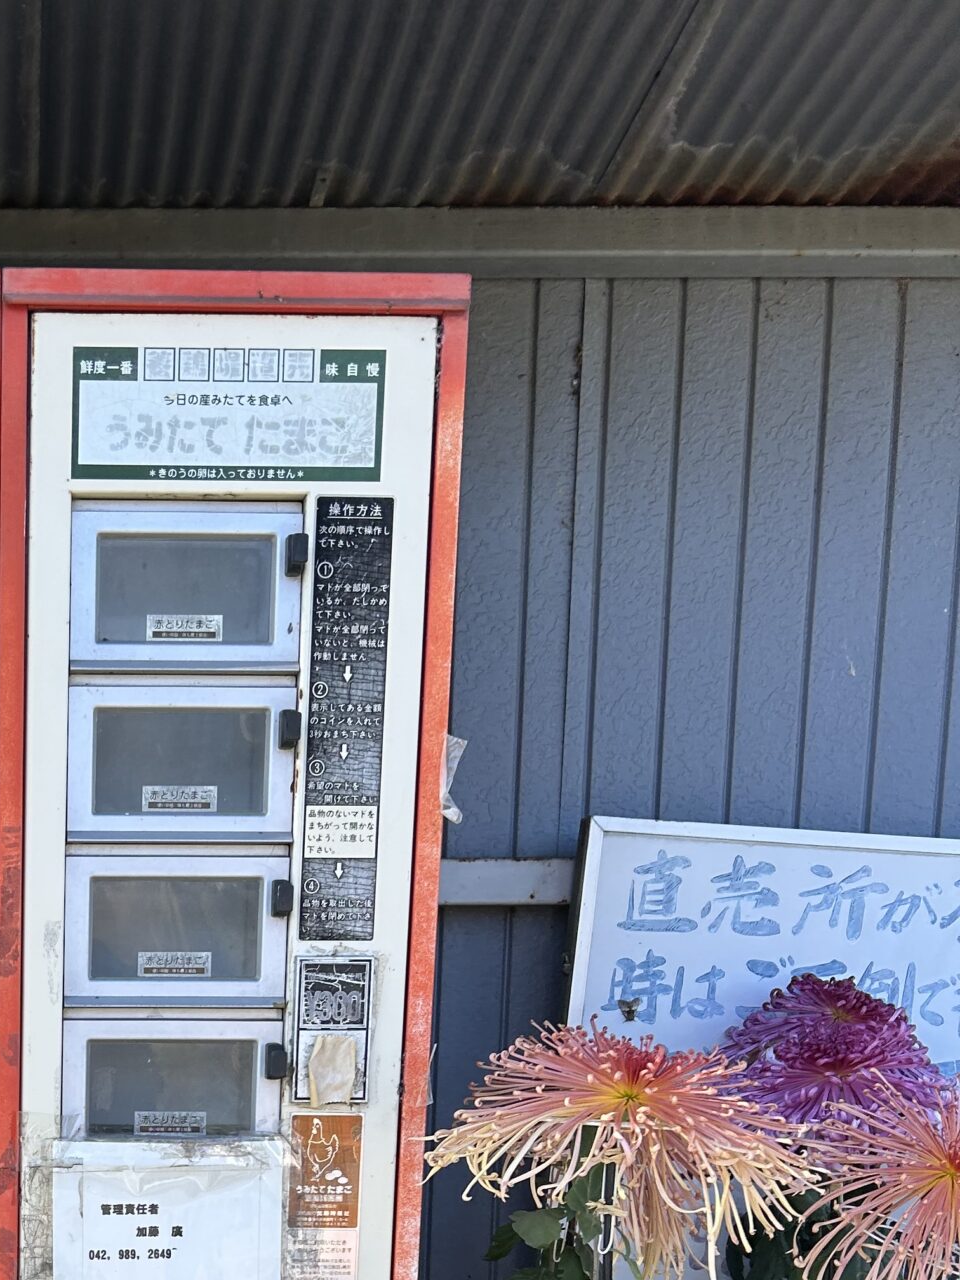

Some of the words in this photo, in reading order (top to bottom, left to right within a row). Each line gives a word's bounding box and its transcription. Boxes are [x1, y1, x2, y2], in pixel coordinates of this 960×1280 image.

[80, 360, 133, 375] 鮮度一番
[325, 362, 380, 377] 味自慢
[164, 393, 293, 407] 今日の産みたてを食卓へ
[329, 502, 382, 516] 操作方法
[319, 525, 390, 536] 次の順序で操作し
[308, 809, 375, 819] 品物のないマドを
[308, 821, 375, 831] まちがって開かな
[307, 834, 374, 843] いよう、注意して
[307, 845, 336, 854] 下さい。
[617, 849, 960, 942] 直売所が
[101, 1203, 159, 1216] 管理責任者
